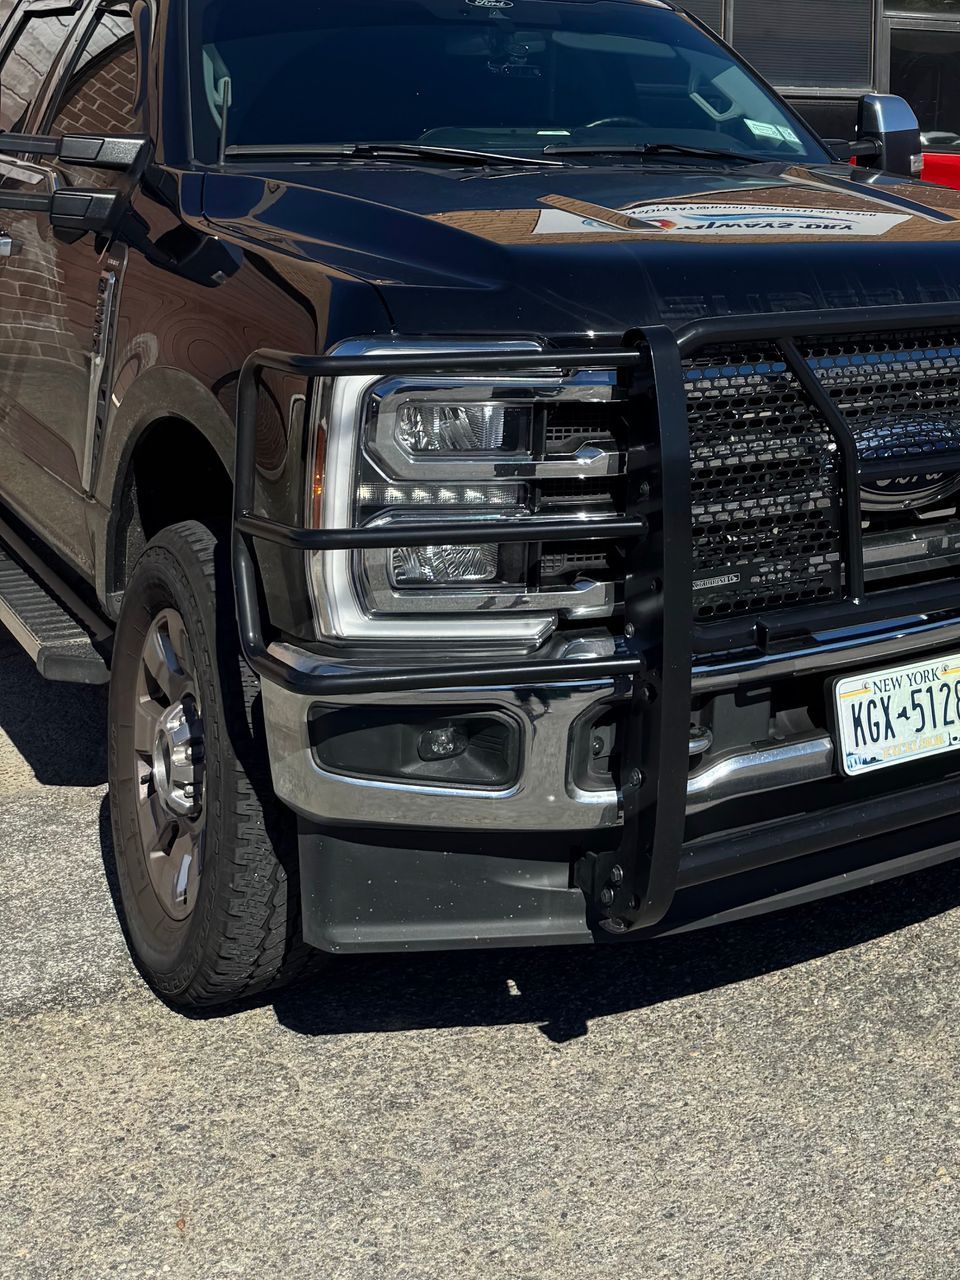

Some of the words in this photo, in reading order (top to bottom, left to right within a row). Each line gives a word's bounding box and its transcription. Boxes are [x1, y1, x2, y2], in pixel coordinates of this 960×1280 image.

[872, 675, 903, 695] NEW
[905, 667, 941, 687] YORK
[851, 695, 896, 748] KGX
